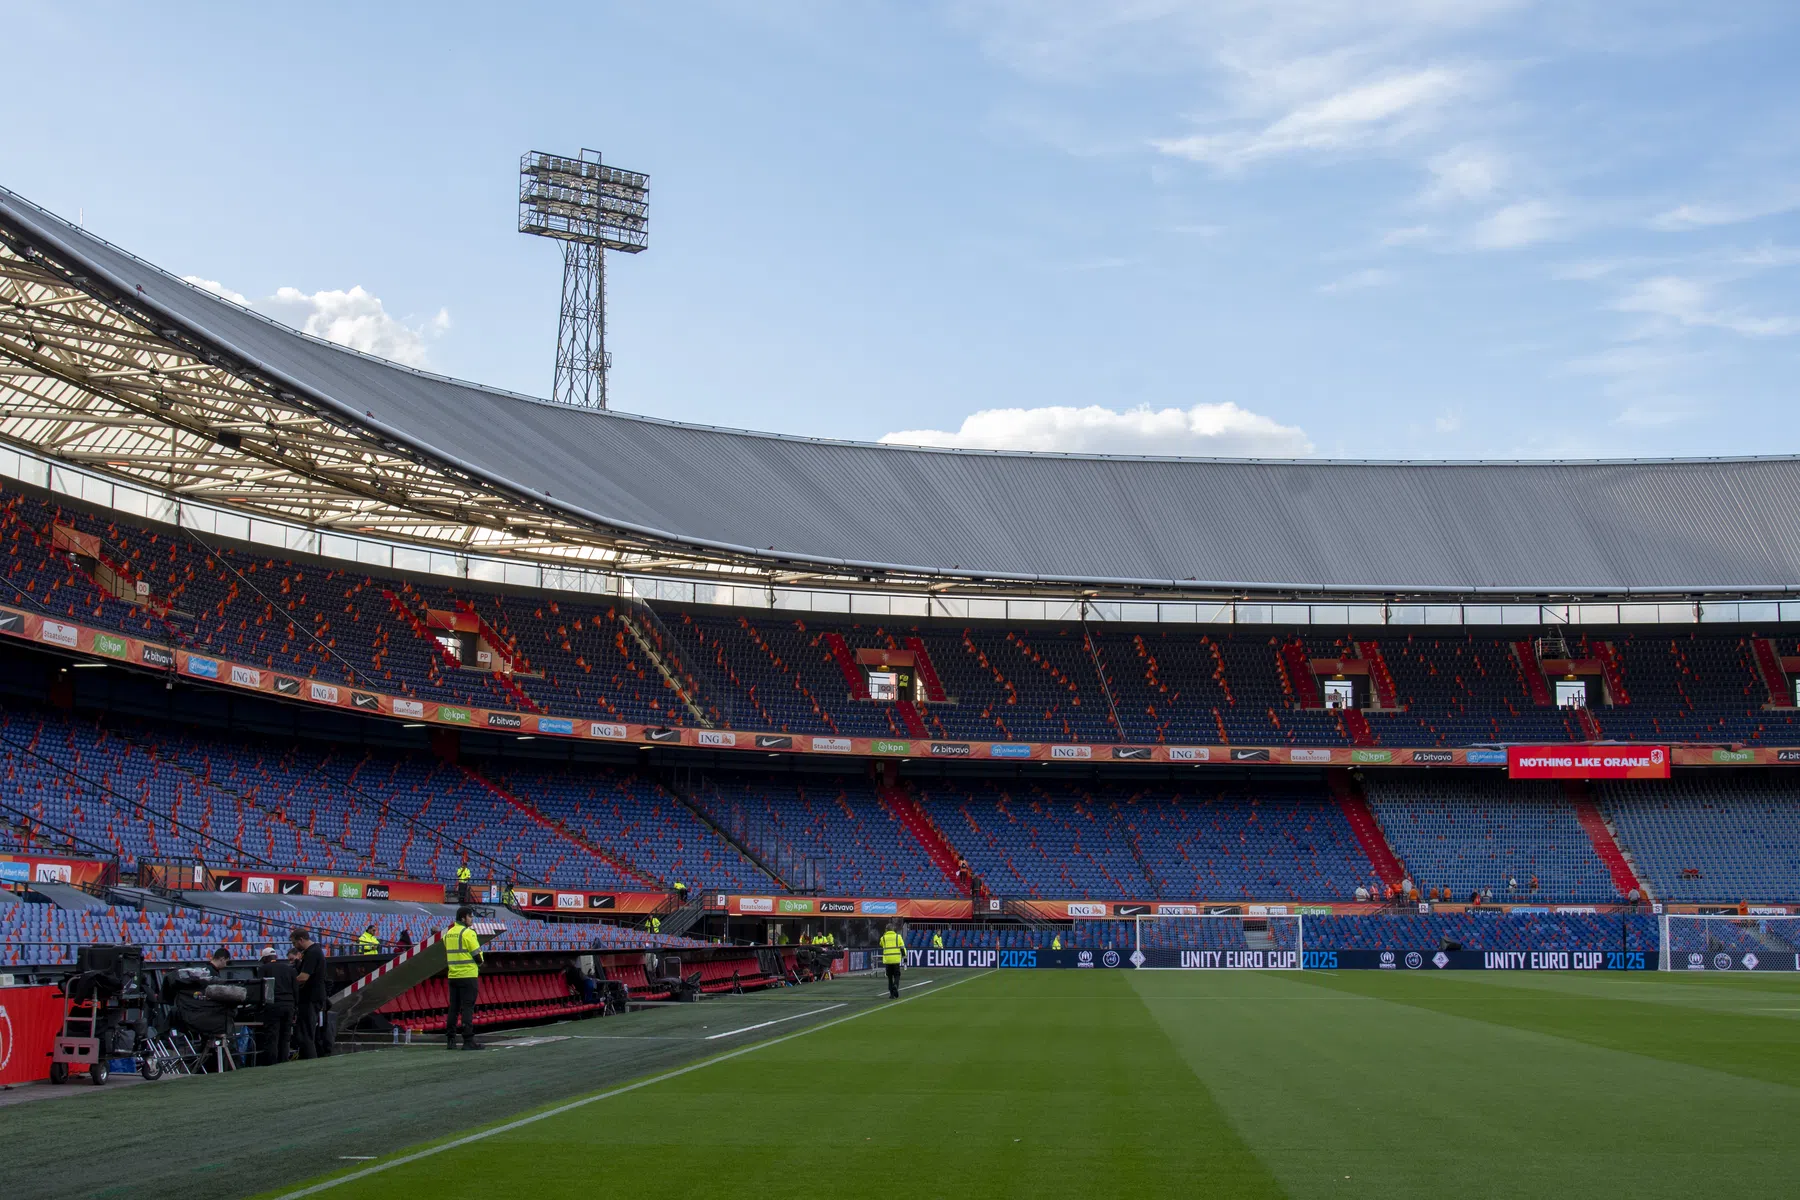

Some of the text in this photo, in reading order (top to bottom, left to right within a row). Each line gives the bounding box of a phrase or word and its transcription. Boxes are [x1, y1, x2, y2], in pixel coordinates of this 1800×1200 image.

[108, 640, 122, 651] kpn
[233, 670, 249, 683] ING
[312, 687, 327, 699] ING
[452, 710, 466, 721] kpn
[496, 717, 521, 726] bitvavo
[592, 726, 611, 736] ING
[700, 734, 720, 744] ING
[813, 743, 851, 752] Staatsloterij
[888, 743, 904, 752] kpn
[941, 745, 969, 754] bitvavo
[1053, 748, 1074, 757] ING
[1171, 750, 1192, 759] ING
[1368, 753, 1385, 761] kpn
[1423, 753, 1452, 761] bitvavo
[1730, 752, 1748, 760] kpn
[1519, 757, 1650, 767] NOTHING LIKE ORANJE
[38, 869, 57, 882] ING
[249, 881, 263, 893] ING
[372, 887, 389, 897] bitvavo
[559, 897, 573, 906] ING
[991, 901, 998, 909] Q
[793, 902, 808, 911] kpn
[828, 902, 854, 911] bitvavo
[1069, 906, 1090, 915] ING
[1420, 904, 1427, 912] R
[927, 950, 964, 967] EURO
[968, 950, 996, 967] CUP
[1000, 950, 1037, 967] 2025
[1180, 951, 1338, 968] UNITY EURO CUP 2025
[1484, 952, 1645, 969] UNITY EURO CUP 2025
